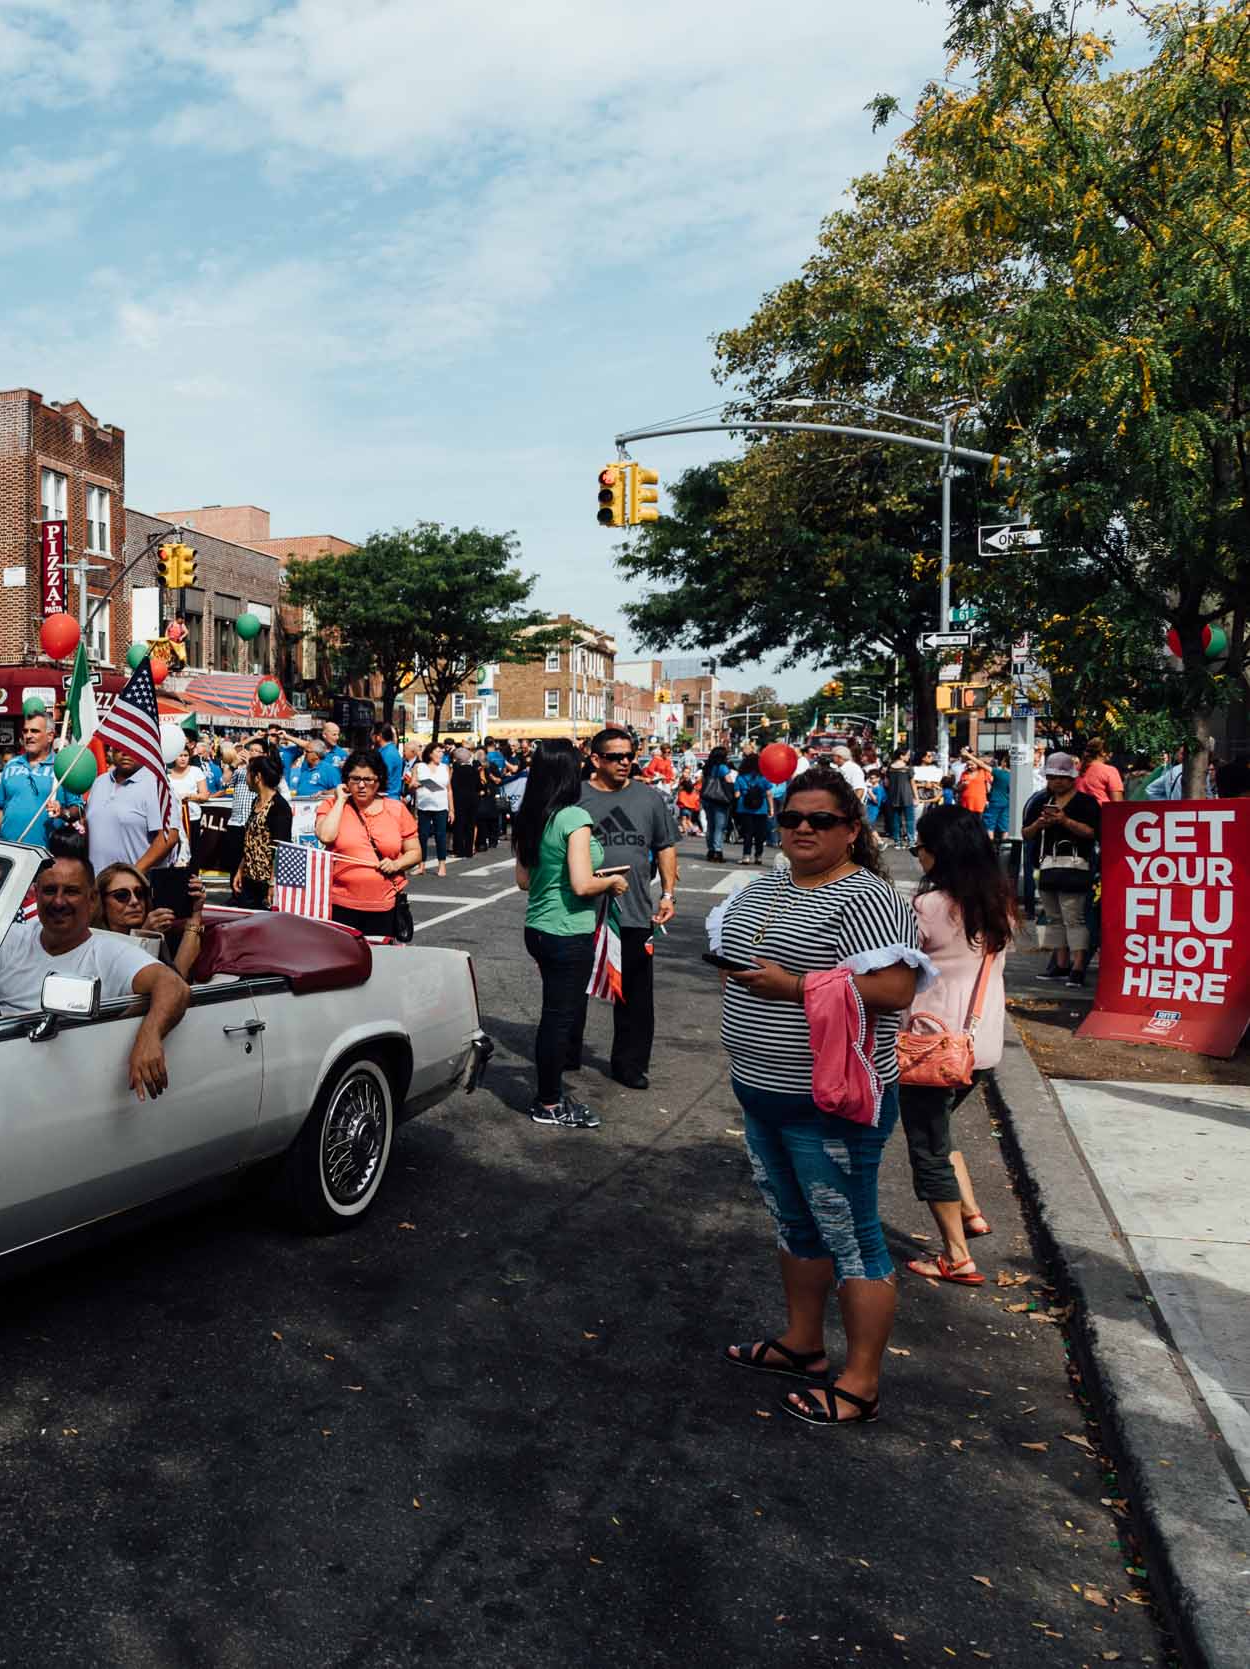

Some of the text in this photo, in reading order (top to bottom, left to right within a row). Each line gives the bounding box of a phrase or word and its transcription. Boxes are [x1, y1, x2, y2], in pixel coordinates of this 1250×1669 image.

[46, 525, 62, 601] PIZZA
[595, 832, 646, 847] didas
[1125, 811, 1235, 853] GET
[1125, 856, 1233, 886] YOUR
[1125, 887, 1233, 935] FLU
[1124, 933, 1232, 970] SHOT
[1153, 1019, 1171, 1027] AID
